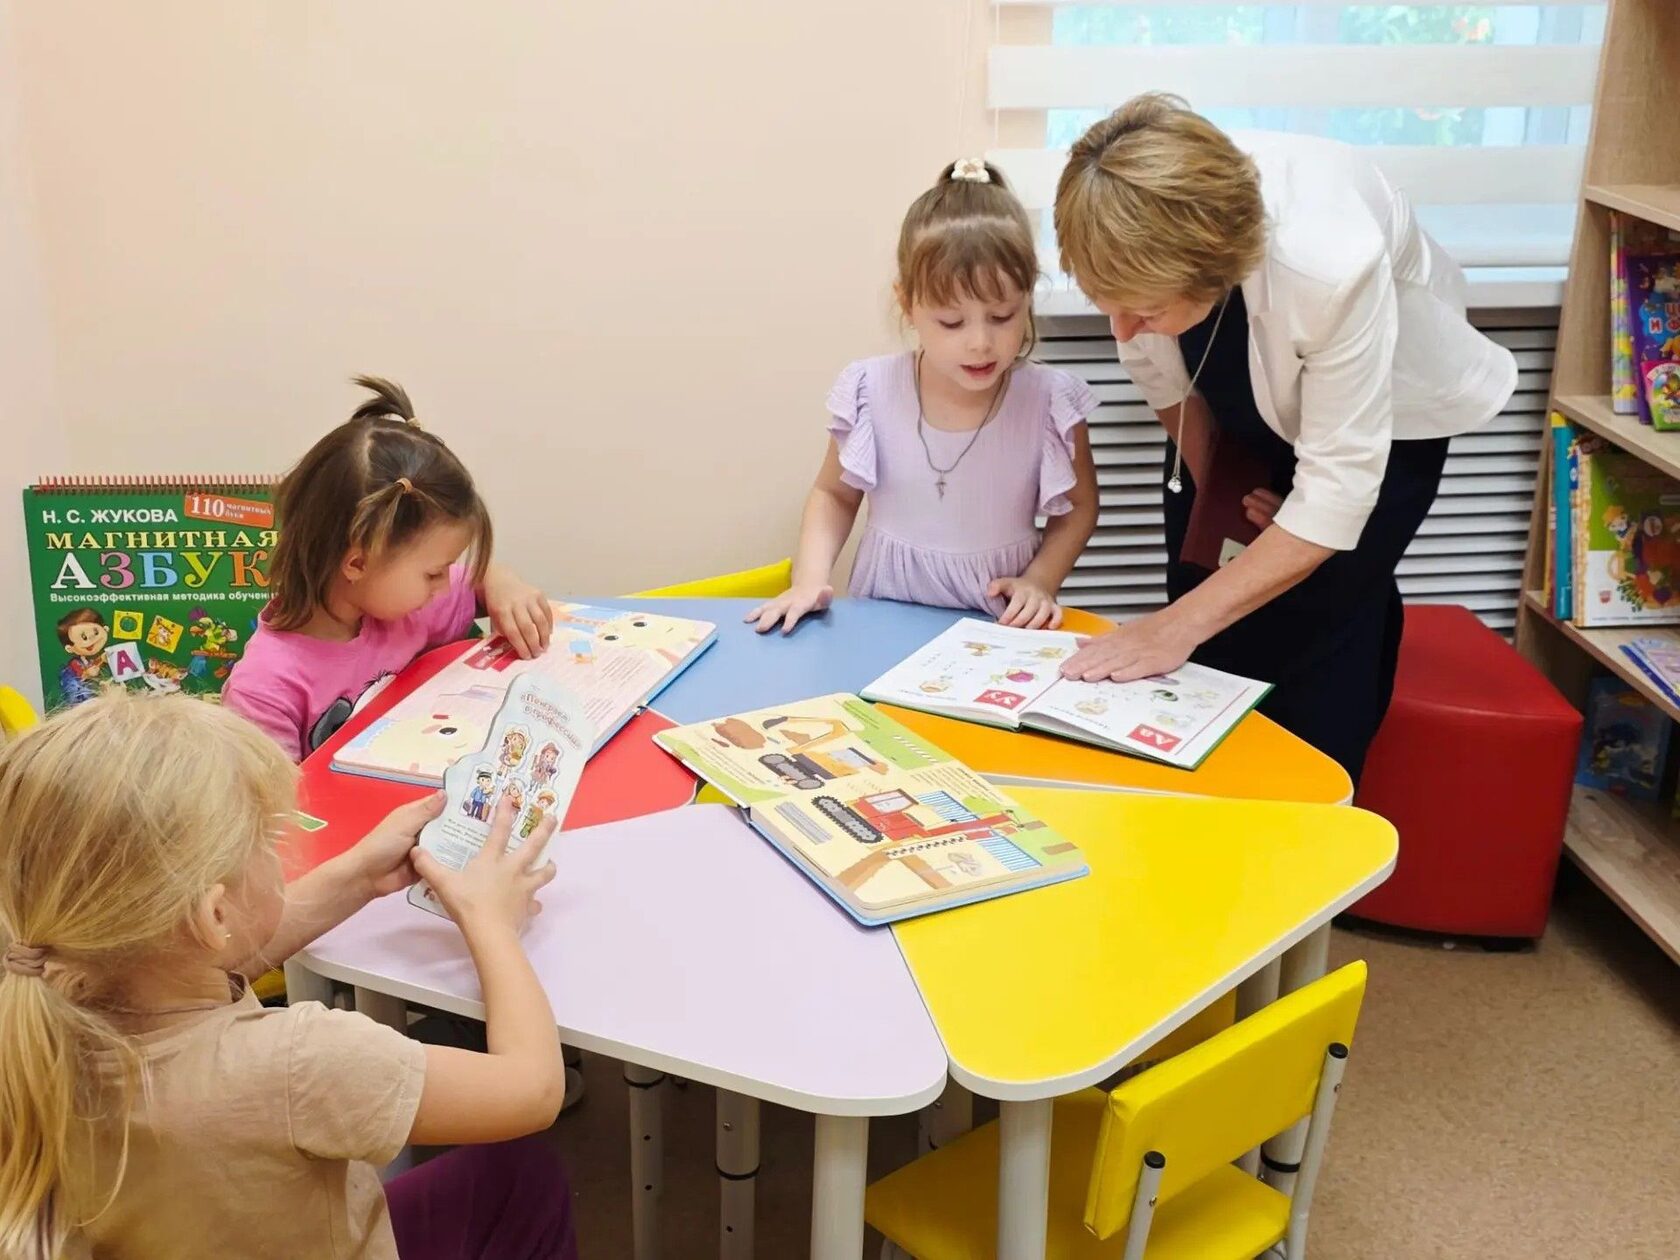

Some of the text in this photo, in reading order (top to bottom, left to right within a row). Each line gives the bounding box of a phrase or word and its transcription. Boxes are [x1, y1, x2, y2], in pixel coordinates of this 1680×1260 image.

[42, 508, 179, 524] Н. С. ЖУКОВА
[191, 496, 225, 518] 110
[45, 530, 280, 550] МАГНИТНАЯ
[50, 550, 272, 589] АЗБУК
[50, 593, 169, 603] Высокоэффективная
[173, 592, 226, 603] методика
